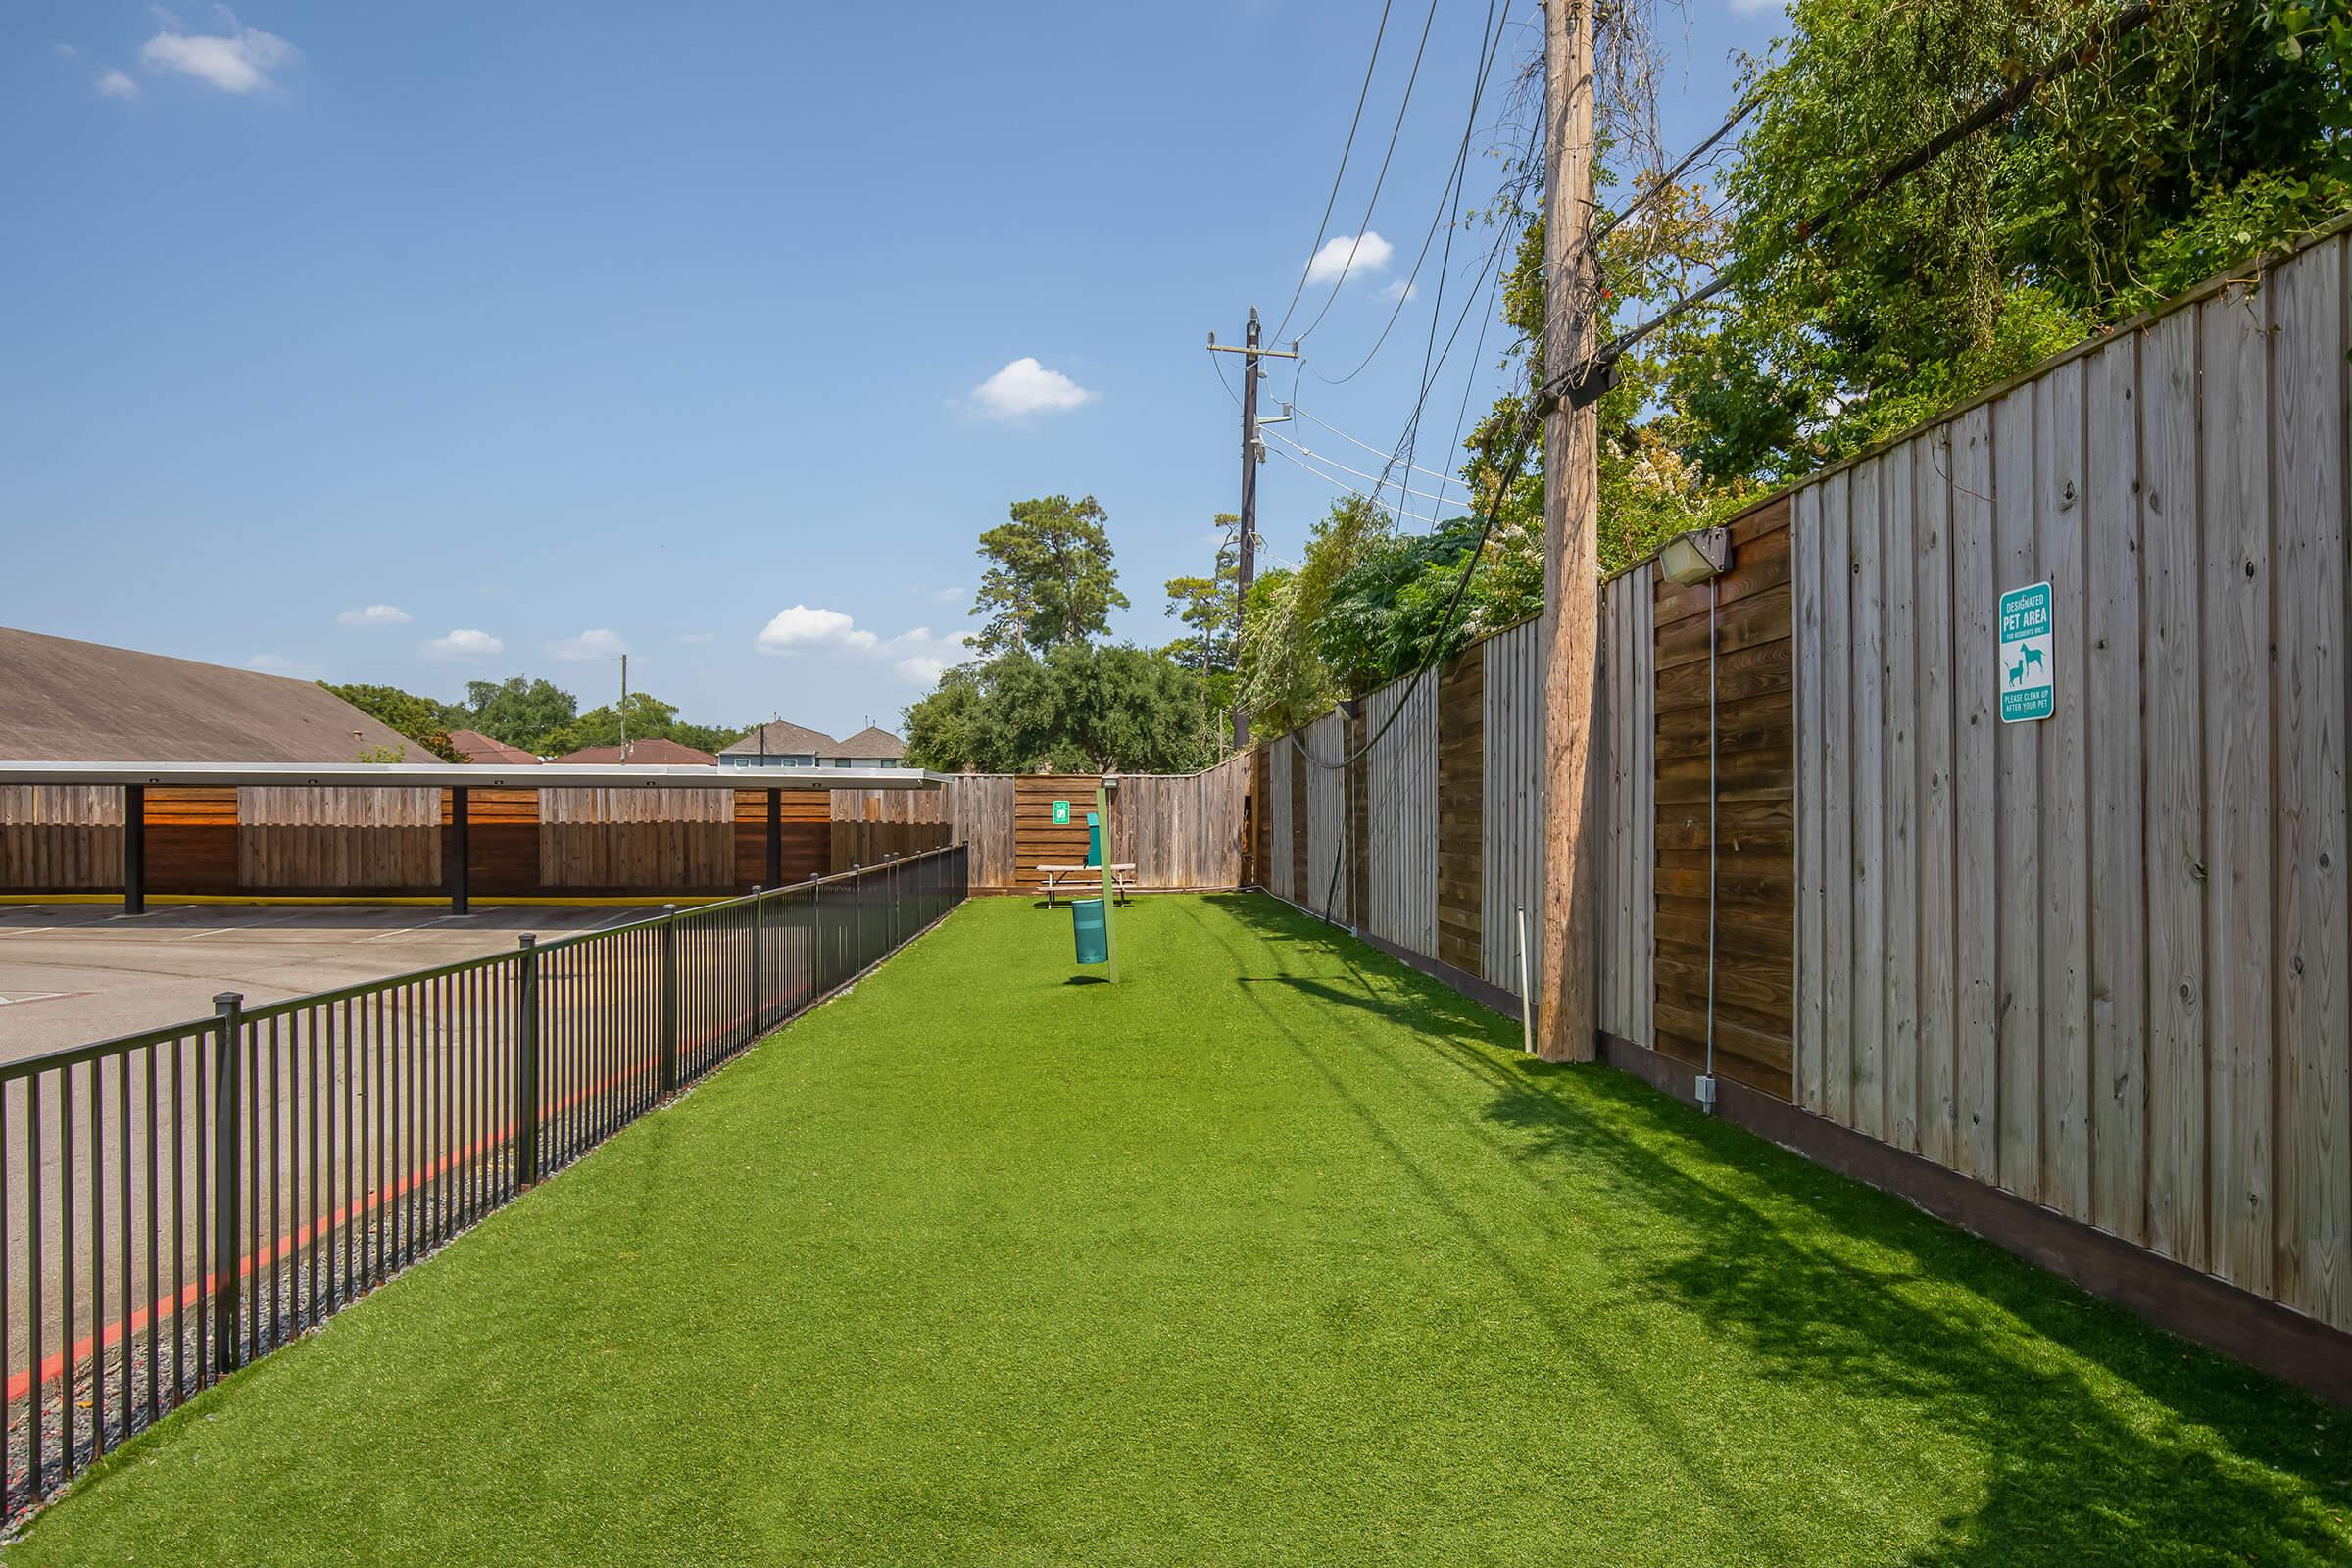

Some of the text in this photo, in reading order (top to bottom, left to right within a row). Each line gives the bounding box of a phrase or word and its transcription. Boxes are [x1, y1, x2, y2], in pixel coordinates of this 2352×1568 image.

[2007, 595, 2043, 612] DESIGNATED
[2004, 608, 2046, 631] PET AREA
[2005, 694, 2023, 704] PLEASE
[2024, 691, 2039, 701] CLEAN
[2006, 699, 2046, 712] AFTER YOUR PET
